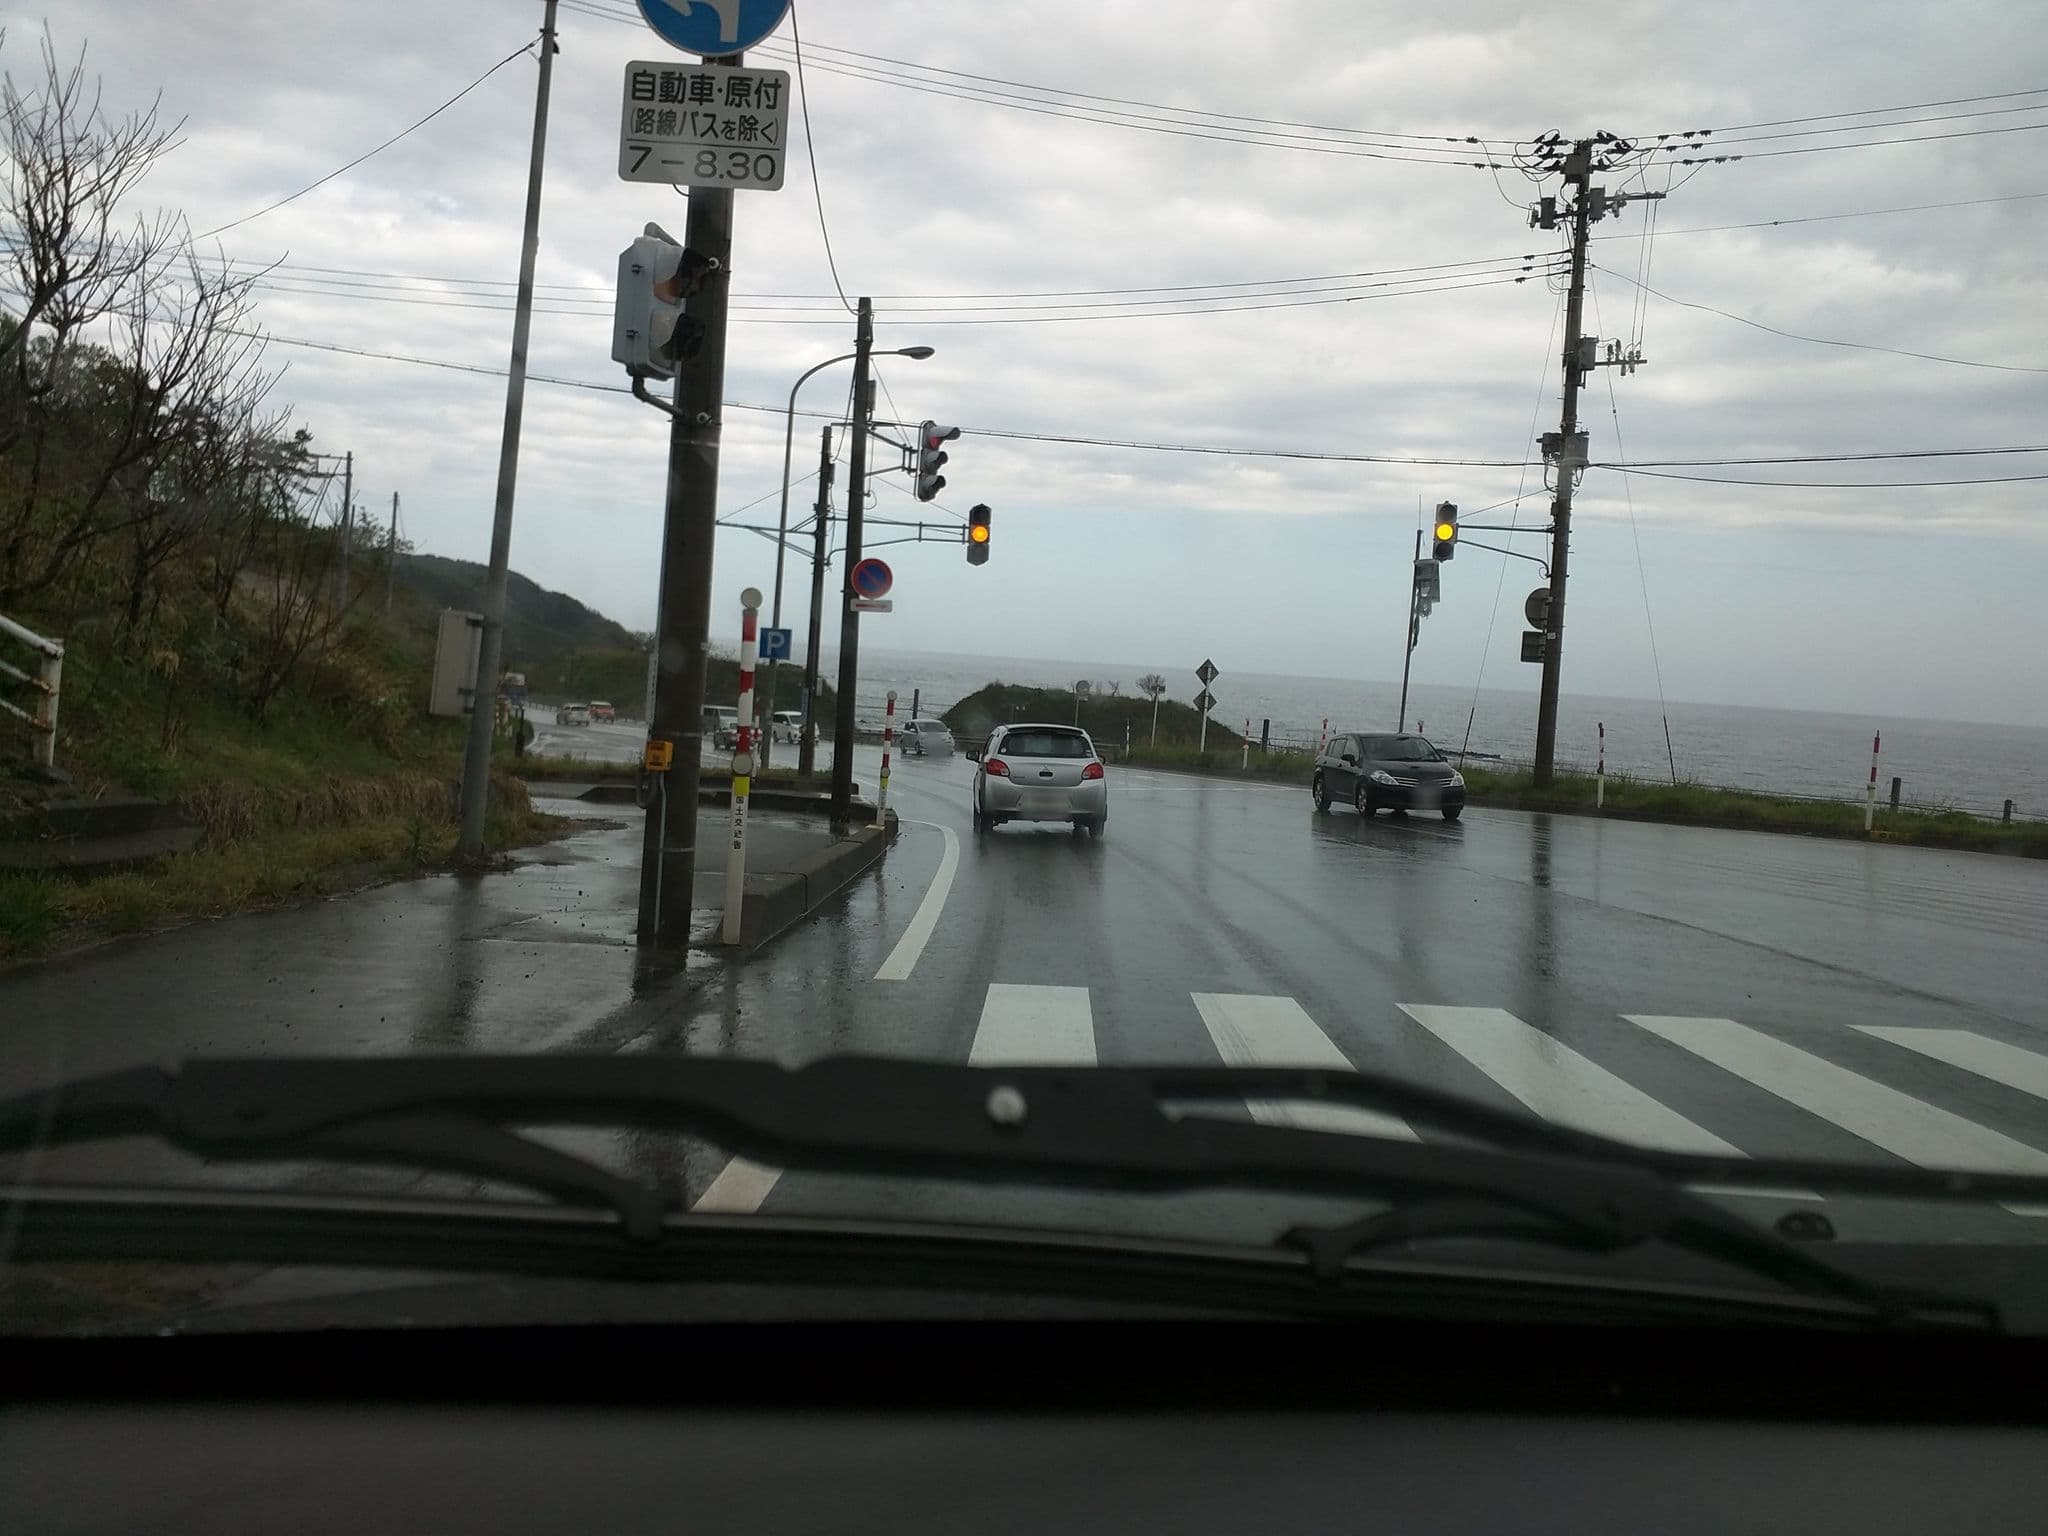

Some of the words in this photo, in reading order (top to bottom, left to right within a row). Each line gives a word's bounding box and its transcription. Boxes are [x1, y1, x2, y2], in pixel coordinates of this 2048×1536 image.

[632, 70, 782, 110] 自動車・原付
[630, 107, 779, 145] (路線バスを除く)
[767, 632, 786, 656] P
